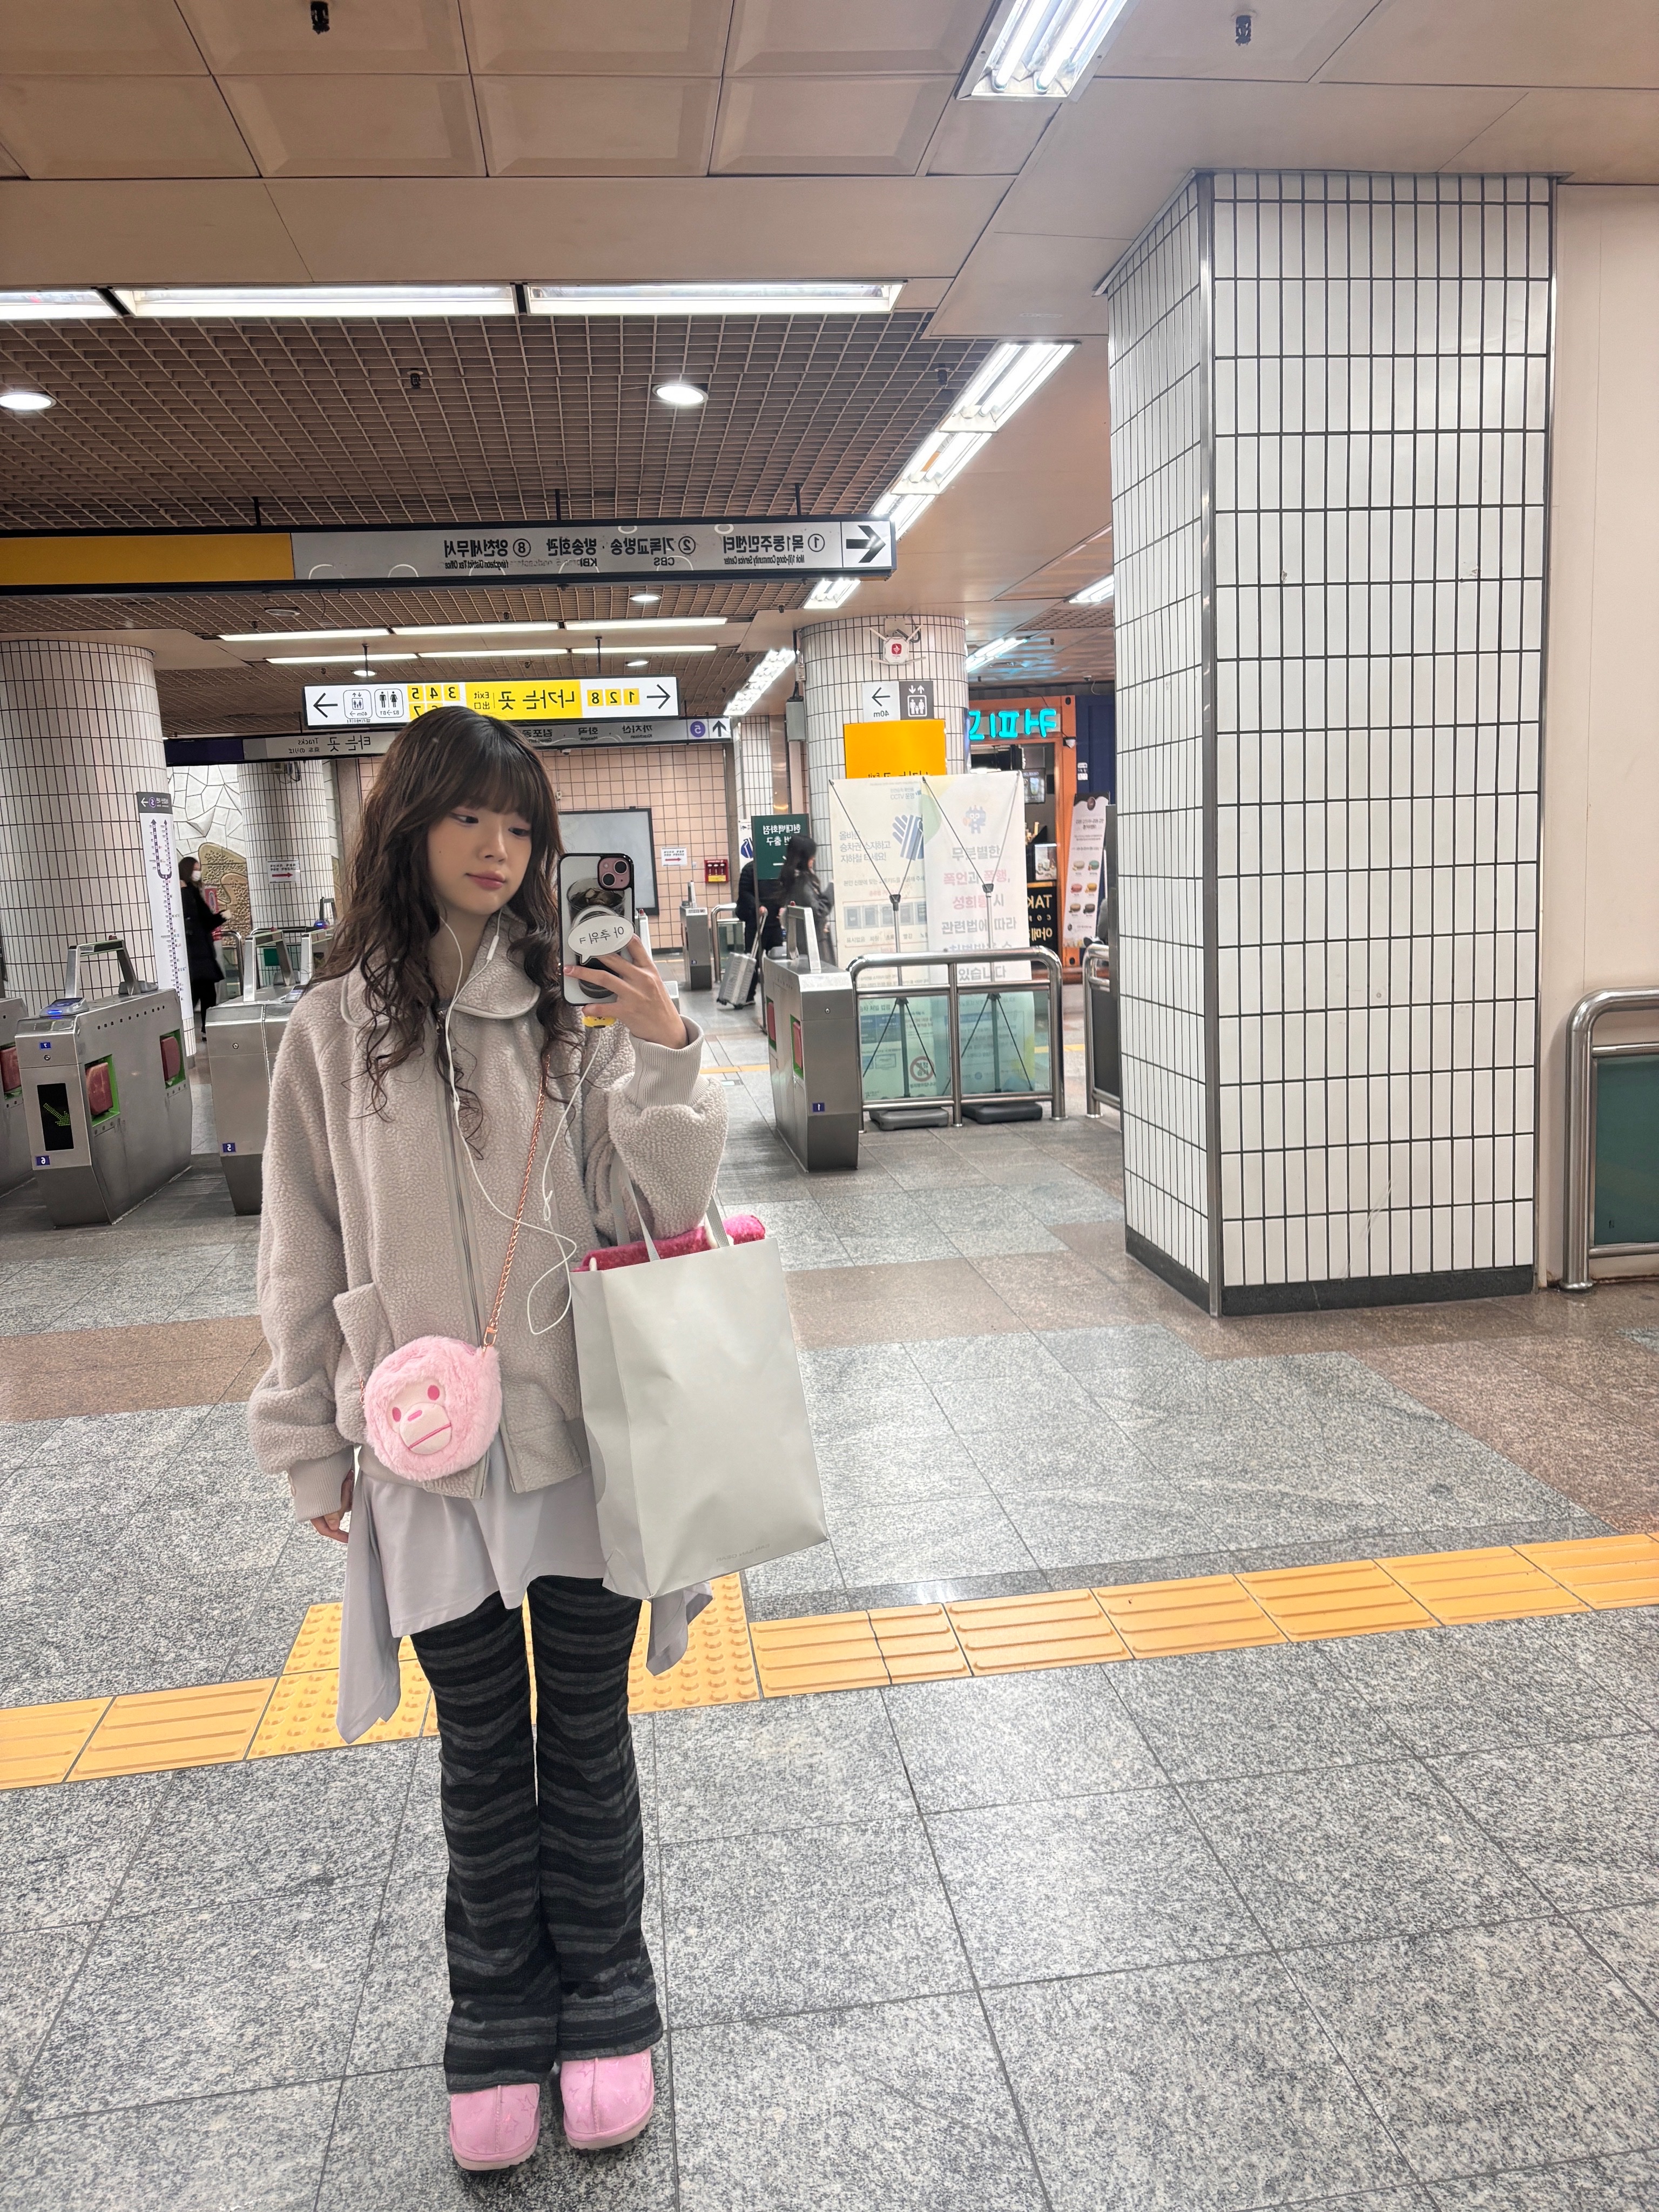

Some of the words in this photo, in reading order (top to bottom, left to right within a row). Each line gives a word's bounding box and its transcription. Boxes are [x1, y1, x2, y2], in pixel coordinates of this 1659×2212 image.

[840, 842, 861, 852] 승차권
[864, 840, 891, 850] 소지하고
[952, 845, 1001, 861] 무분별한
[841, 853, 862, 864] 지하철
[943, 871, 979, 886] 폭언과
[953, 895, 987, 910] 성희롱
[993, 893, 1004, 907] 시
[942, 919, 988, 934] 관련법에
[994, 916, 1016, 930] 따라
[959, 965, 1006, 981] 있습니다
